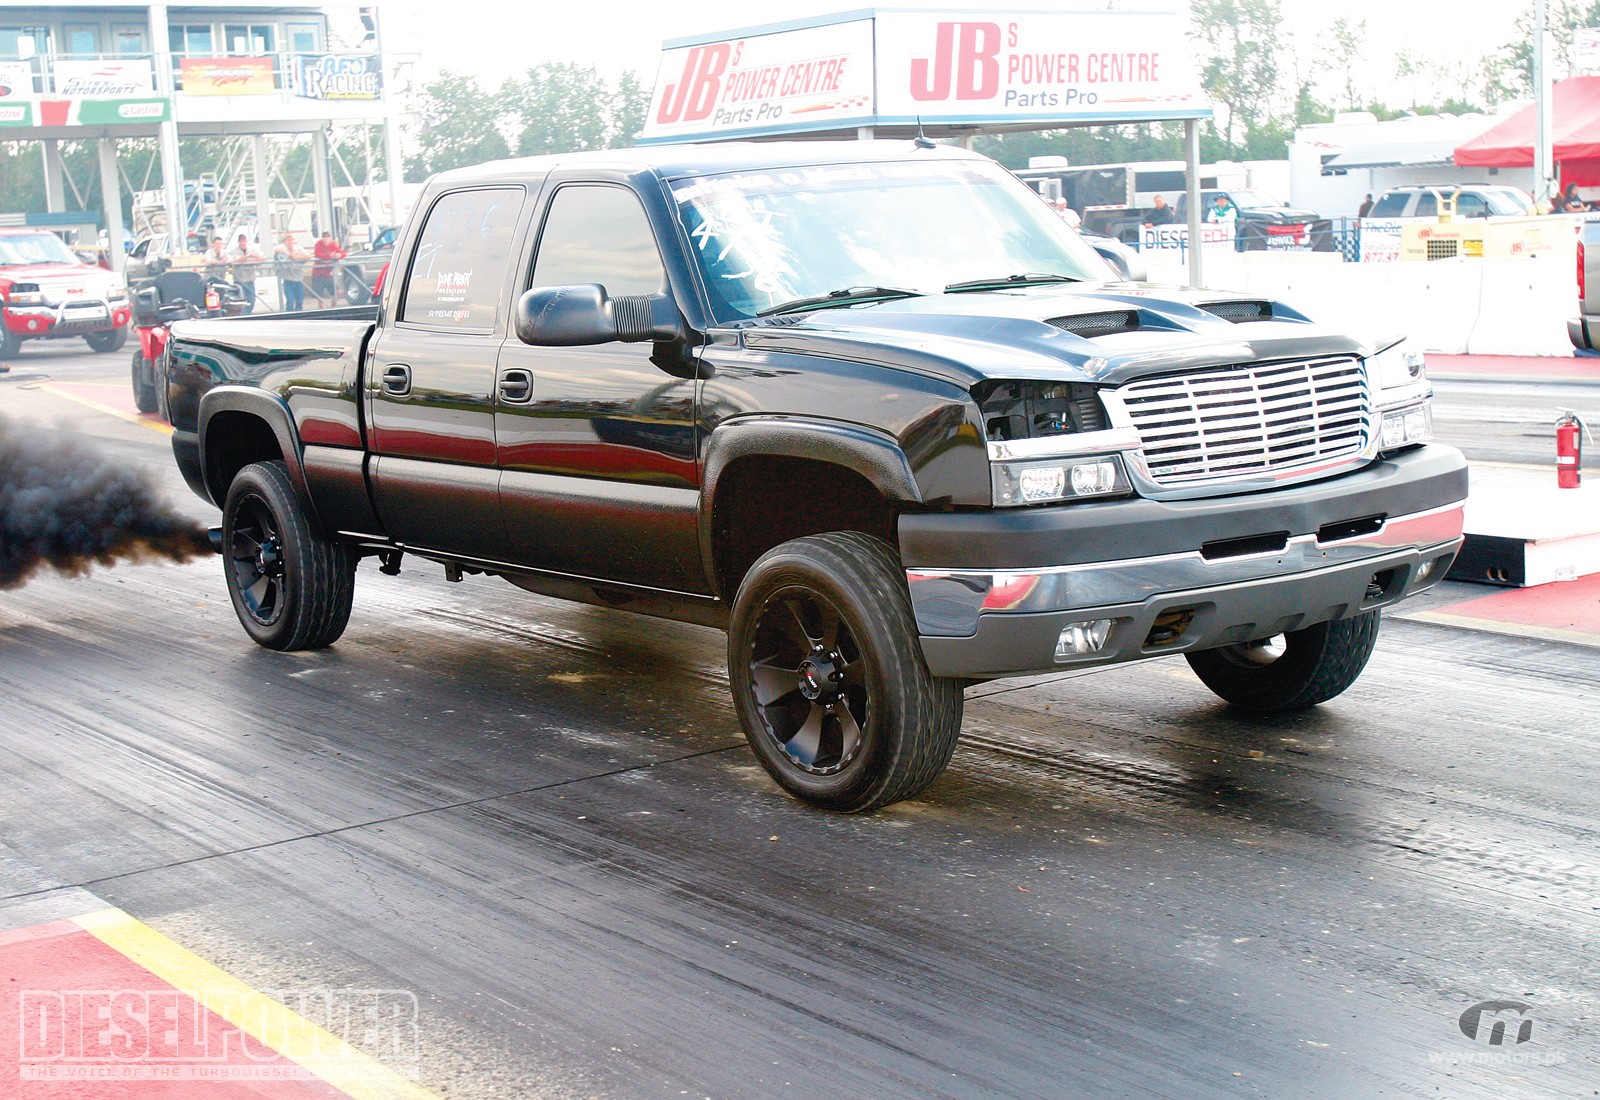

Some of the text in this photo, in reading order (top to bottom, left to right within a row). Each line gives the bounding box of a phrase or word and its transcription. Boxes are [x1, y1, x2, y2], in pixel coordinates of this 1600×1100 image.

[1008, 52, 1160, 84] POWER CENTRE
[721, 57, 848, 103] POWER CENTRE
[61, 86, 136, 95] MOTORSPORTS
[1004, 88, 1098, 107] Parts Pro
[130, 106, 160, 115] Castrol
[713, 103, 783, 126] Parts Pro
[1145, 230, 1189, 249] DIESE
